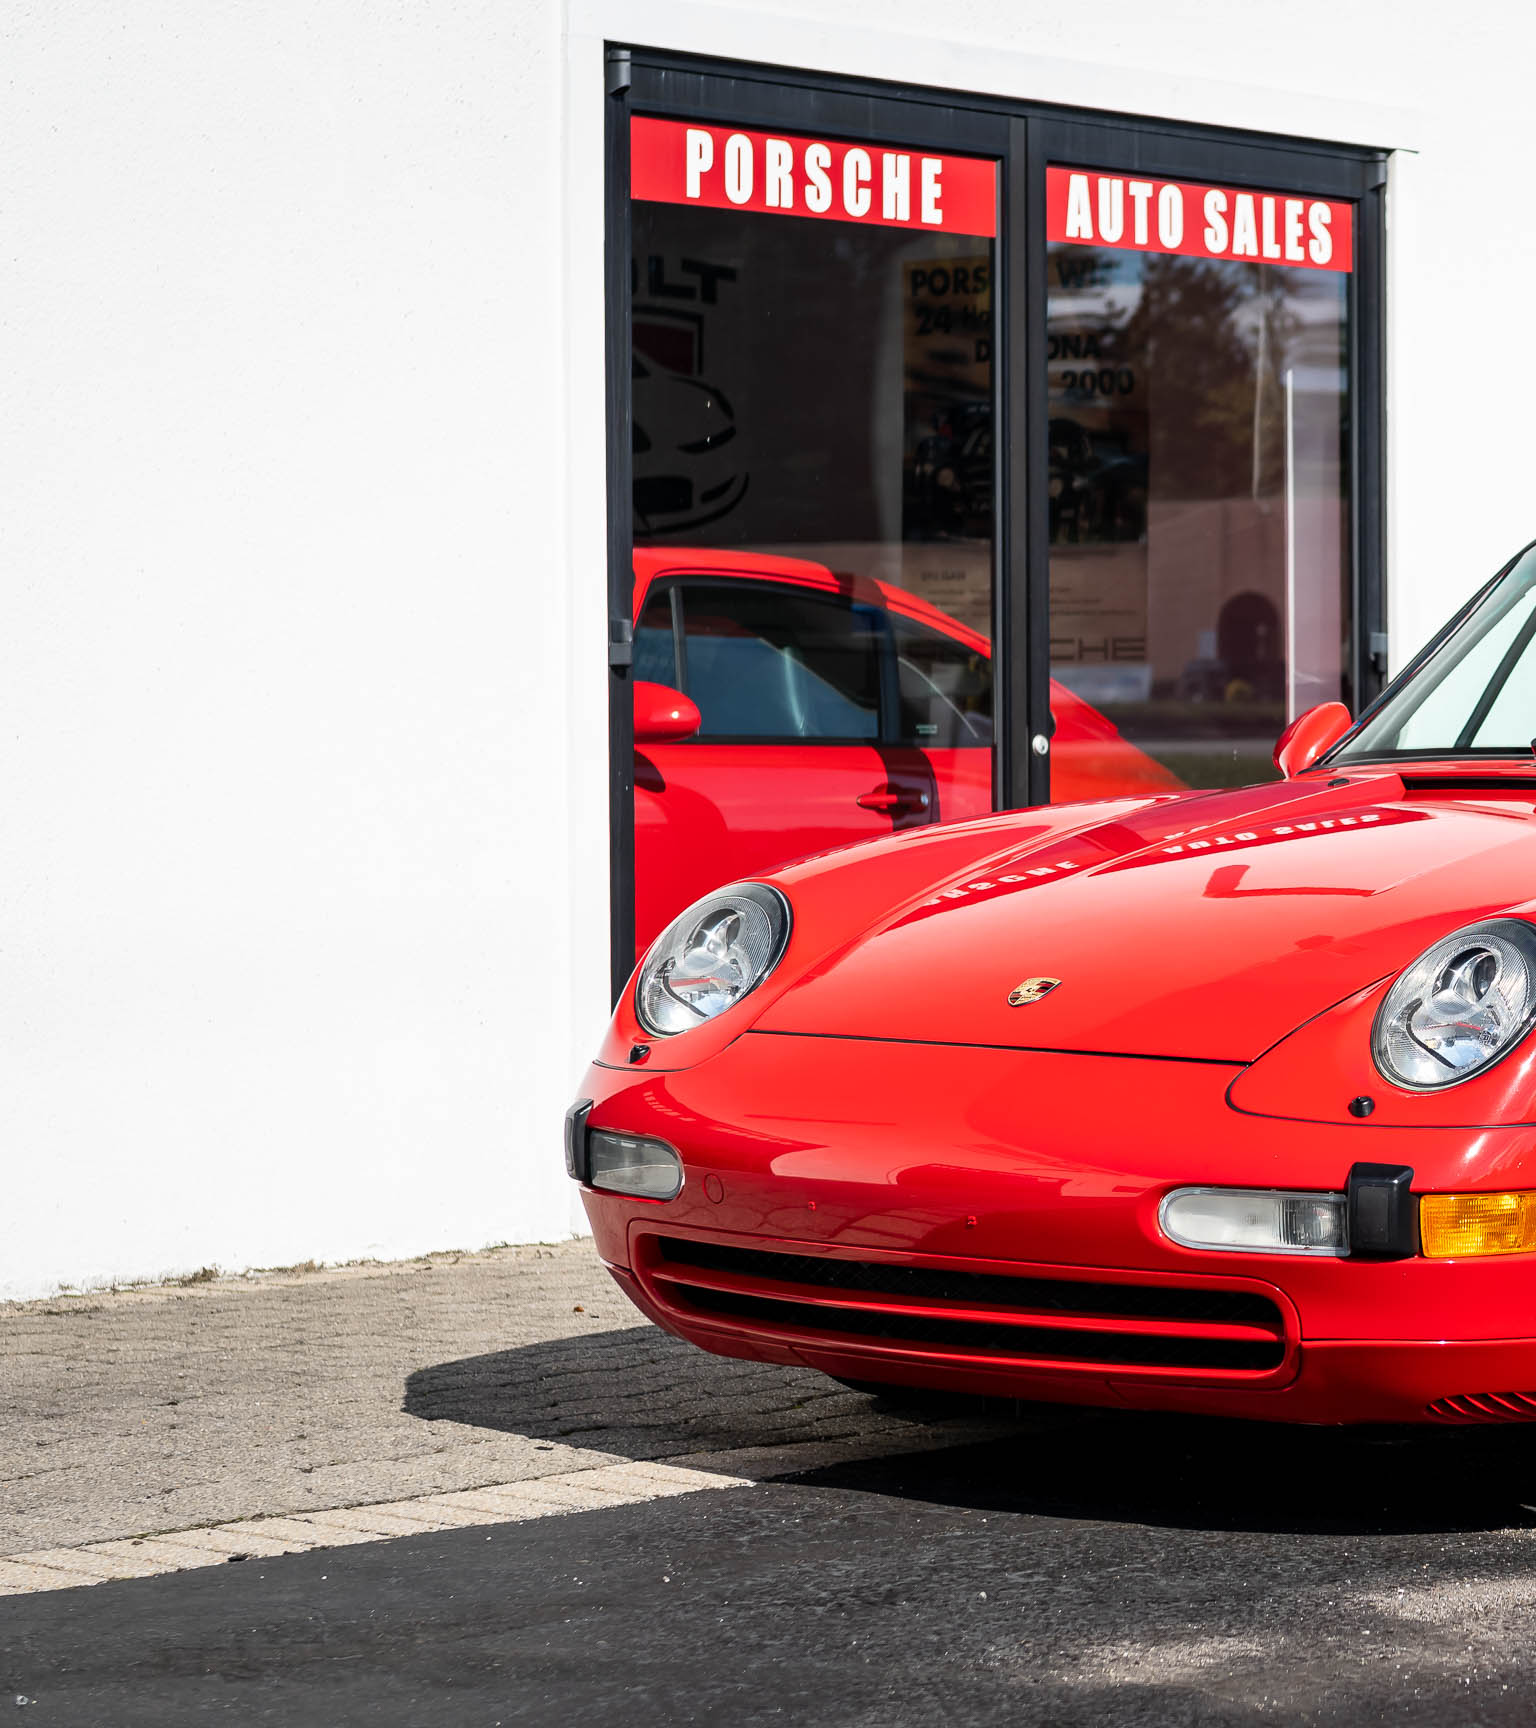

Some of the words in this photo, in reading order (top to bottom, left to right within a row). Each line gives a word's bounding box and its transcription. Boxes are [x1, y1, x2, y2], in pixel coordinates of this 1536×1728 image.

[685, 127, 943, 225] PORSCHE
[1065, 173, 1184, 249] AUTO
[1203, 189, 1333, 265] SALES
